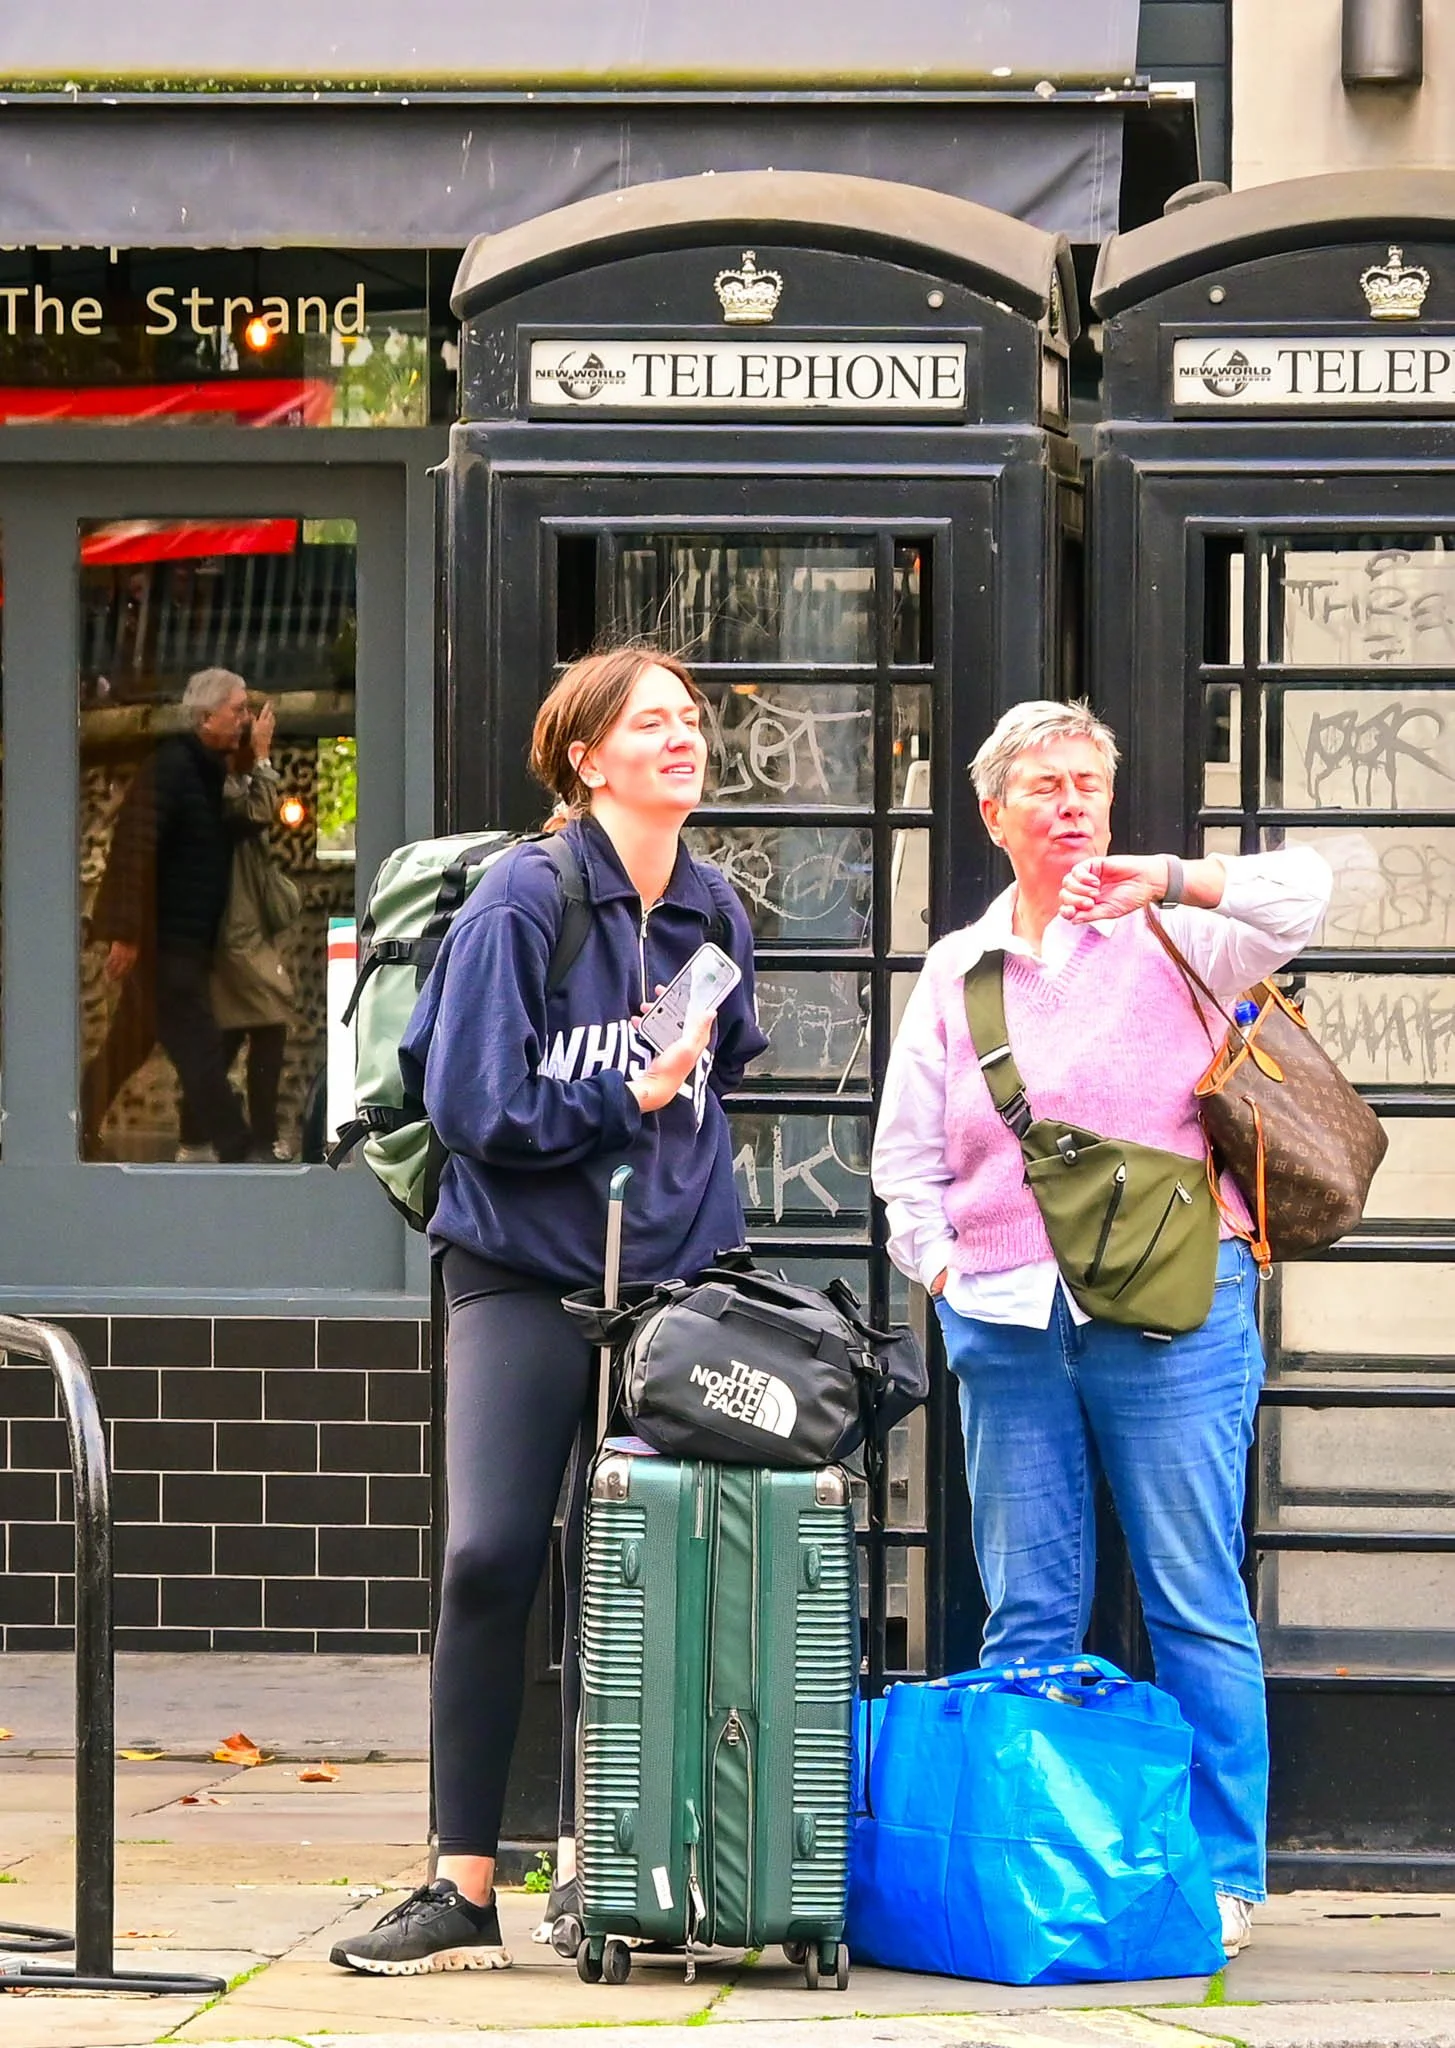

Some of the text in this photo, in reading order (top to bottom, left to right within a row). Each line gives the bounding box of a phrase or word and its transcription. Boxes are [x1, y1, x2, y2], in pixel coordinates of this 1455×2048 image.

[0, 283, 365, 335] The Strand
[535, 369, 626, 378] NEW WORLD
[632, 353, 962, 399] TELEPHONE
[1179, 367, 1272, 376] NEW WORLD
[1277, 350, 1455, 394] TELEP
[689, 1364, 765, 1412] NORTH
[730, 1360, 770, 1389] THE
[702, 1389, 757, 1424] FACE
